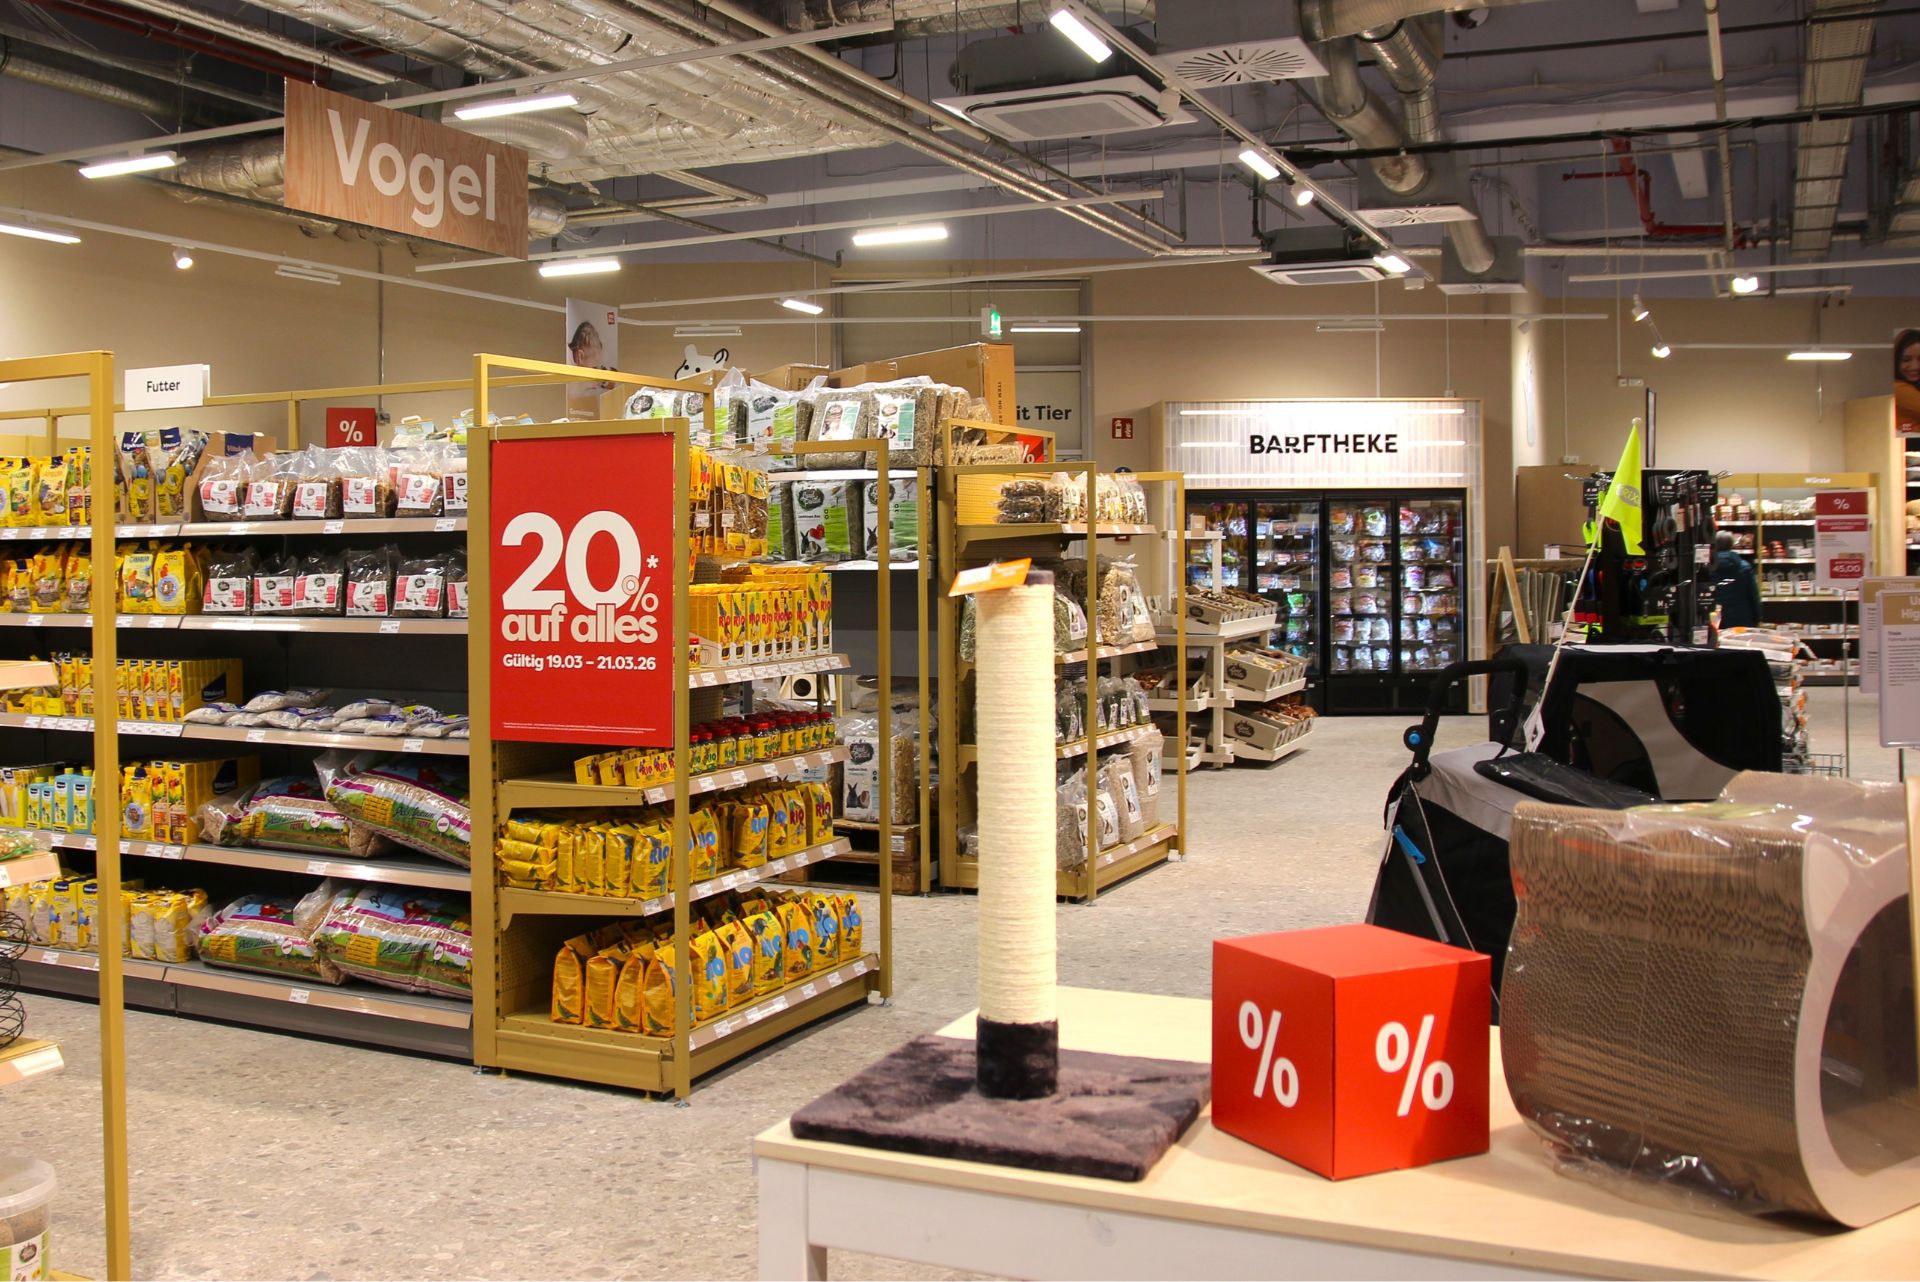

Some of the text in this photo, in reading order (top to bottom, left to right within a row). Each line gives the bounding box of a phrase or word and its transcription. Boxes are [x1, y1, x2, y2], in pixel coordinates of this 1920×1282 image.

[328, 108, 496, 228] Vogel
[146, 380, 181, 393] Futter
[1016, 406, 1030, 420] it
[1035, 406, 1072, 420] Tier
[339, 420, 363, 443] %
[1250, 434, 1398, 454] BARFTHEKE
[501, 603, 659, 644] auf alles
[719, 616, 731, 627] RIO
[734, 616, 745, 626] RIO
[762, 613, 773, 624] RIO
[503, 653, 544, 671] Gültig
[547, 655, 583, 669] 19.03
[597, 656, 656, 670] 21.03.26
[642, 765, 652, 775] RIO
[656, 762, 667, 771] RIO
[790, 809, 804, 826] RIO
[816, 802, 831, 816] RIO
[650, 845, 670, 864] RIO
[1239, 1000, 1299, 1108] %
[1376, 1014, 1454, 1117] %
